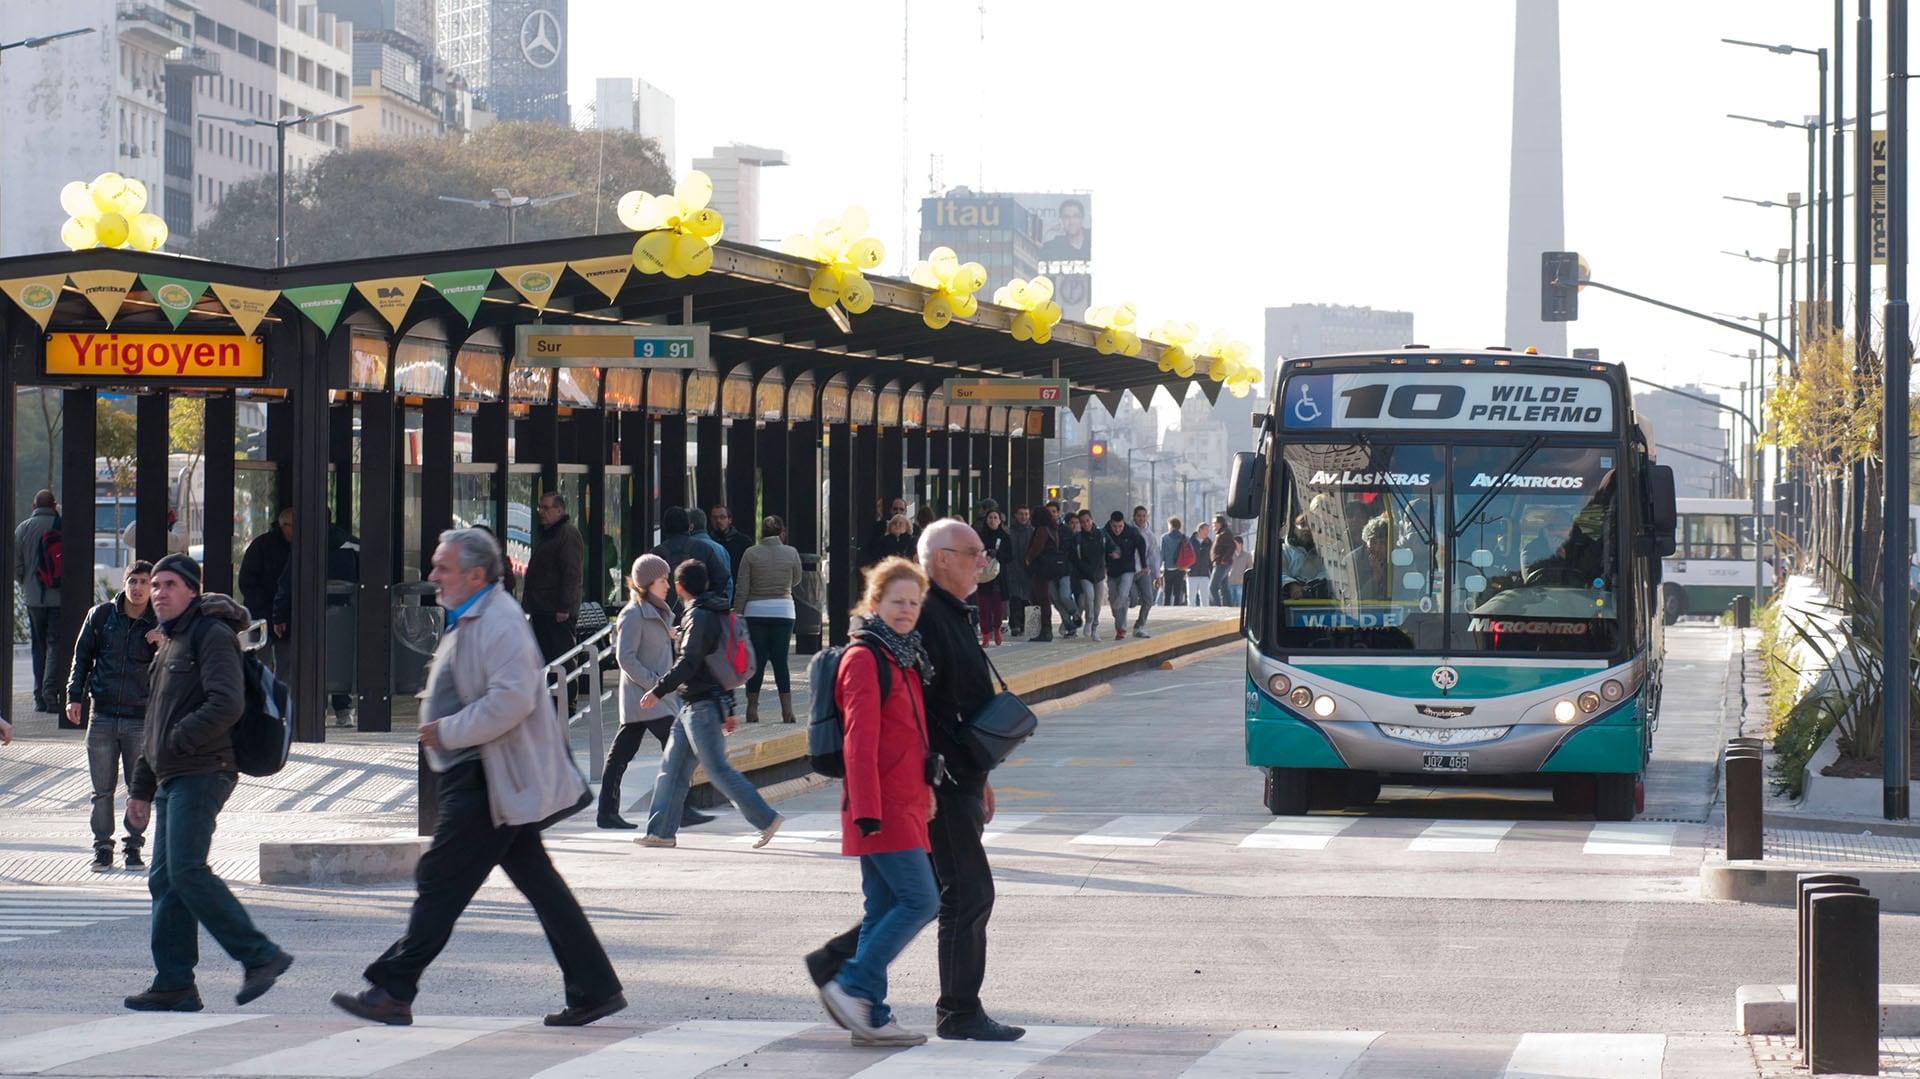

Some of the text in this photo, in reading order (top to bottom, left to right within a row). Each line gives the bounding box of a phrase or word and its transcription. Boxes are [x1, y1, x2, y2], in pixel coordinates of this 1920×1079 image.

[935, 200, 1000, 227] Itaú
[443, 283, 485, 295] metrobus
[68, 334, 241, 375] Yrigoyen
[537, 340, 688, 358] Sur 9 91
[957, 388, 1057, 400] Sur 67
[1340, 384, 1467, 420] 10
[1492, 386, 1580, 403] WILDE
[1469, 405, 1603, 424] PALERMO
[1302, 612, 1399, 628] WILDE
